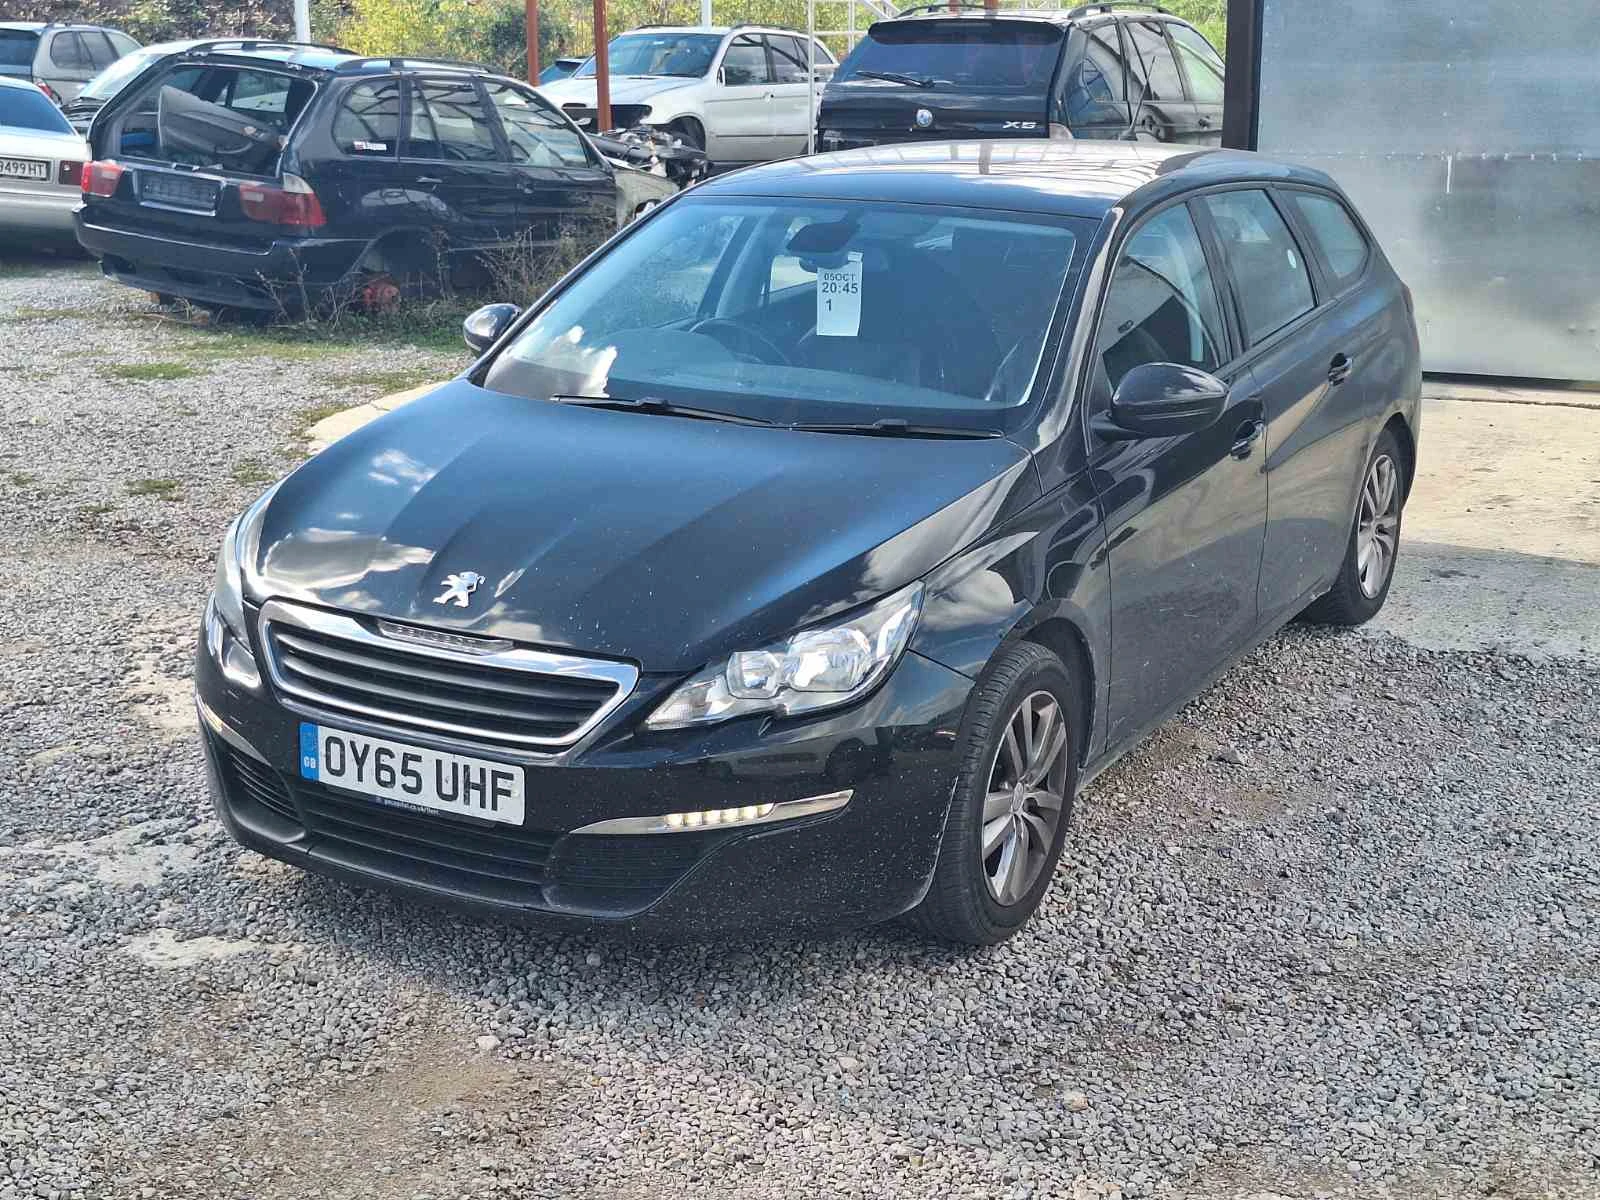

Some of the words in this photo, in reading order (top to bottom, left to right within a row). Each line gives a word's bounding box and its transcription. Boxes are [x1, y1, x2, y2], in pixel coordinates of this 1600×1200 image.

[824, 272, 856, 281] 05OCT
[822, 282, 858, 294] 20:45
[825, 299, 832, 311] 1
[325, 735, 423, 795] OY65
[435, 758, 515, 812] UHF
